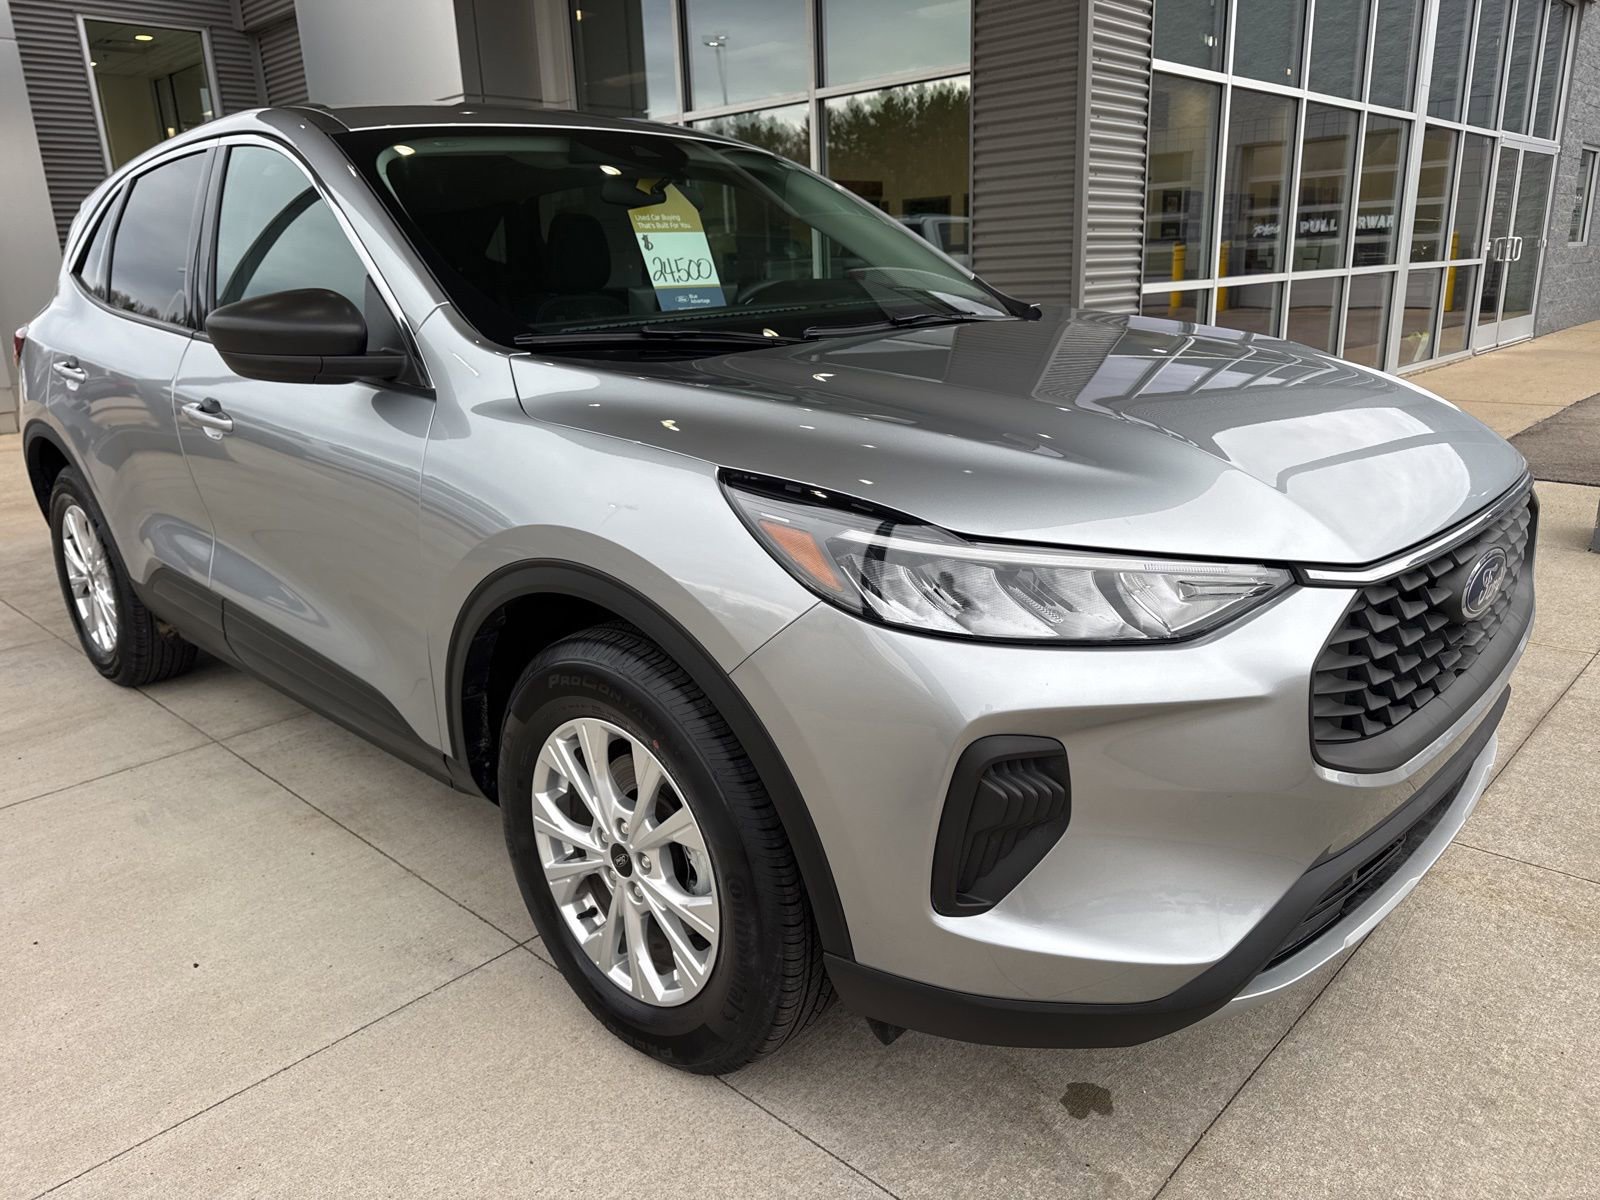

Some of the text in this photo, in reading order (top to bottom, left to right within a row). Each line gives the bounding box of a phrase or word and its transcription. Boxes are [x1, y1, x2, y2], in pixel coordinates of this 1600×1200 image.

[656, 221, 669, 229] Built
[661, 214, 681, 223] Buying
[1300, 218, 1338, 233] PULL
[642, 234, 654, 251] $
[653, 257, 712, 283] 24,500
[1477, 563, 1501, 606] Ford
